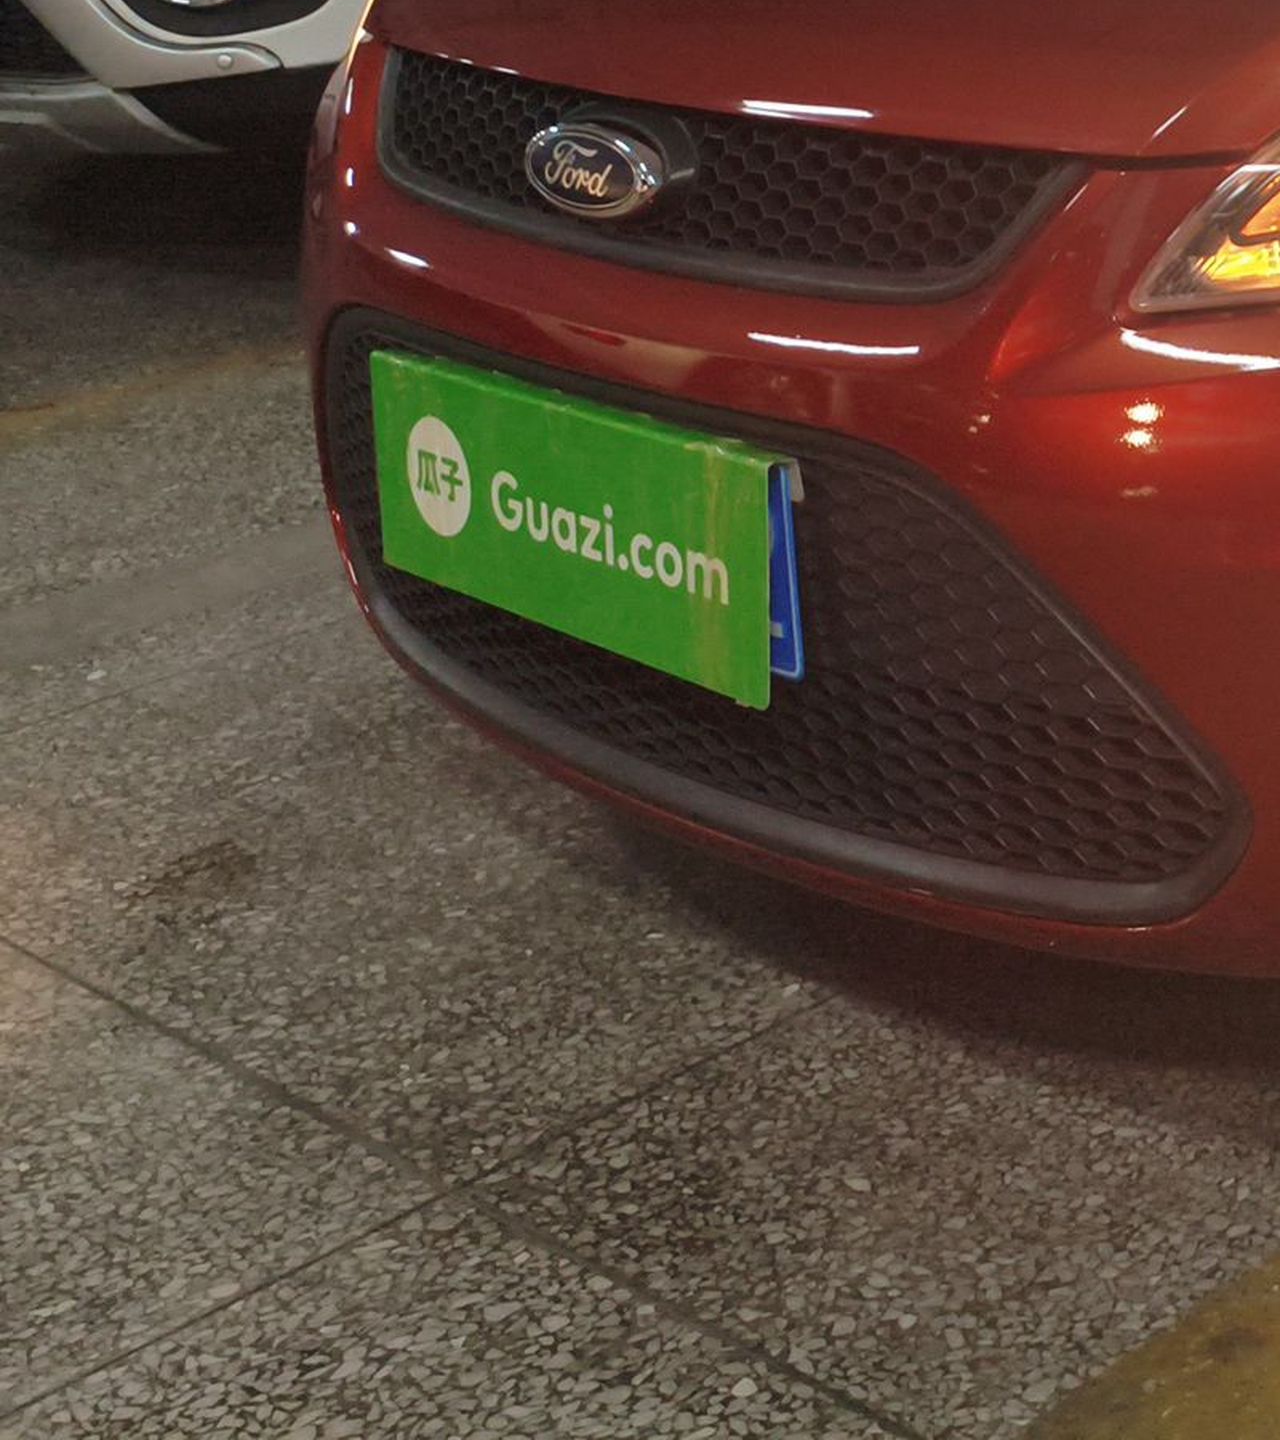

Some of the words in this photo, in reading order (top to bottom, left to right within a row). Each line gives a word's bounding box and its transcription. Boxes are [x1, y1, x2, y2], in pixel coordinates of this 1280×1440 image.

[544, 140, 614, 197] Ford
[417, 449, 463, 502] 瓜子
[491, 470, 730, 605] Guazi.com
